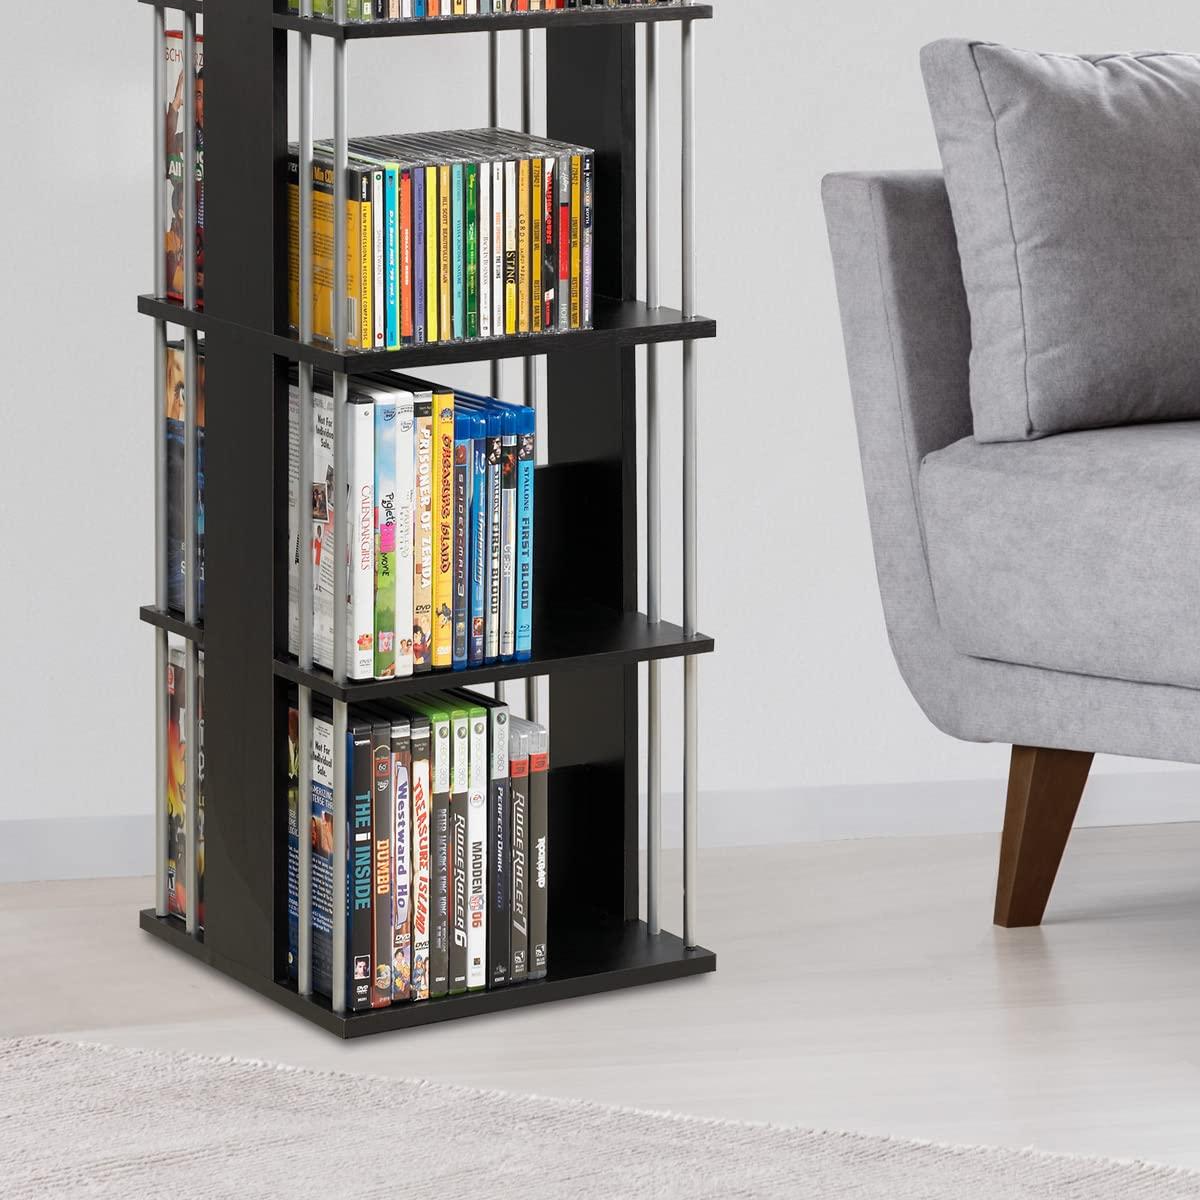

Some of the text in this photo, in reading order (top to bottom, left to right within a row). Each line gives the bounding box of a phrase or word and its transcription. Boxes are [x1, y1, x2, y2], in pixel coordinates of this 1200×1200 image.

[381, 492, 396, 527] Piglet's
[419, 428, 432, 590] PRISONER OF ZENDA
[474, 512, 485, 585] Underdog
[491, 521, 500, 562] FIRST
[521, 517, 530, 557] FIRST
[457, 583, 464, 597] 3
[491, 567, 499, 615] BLOOD
[521, 562, 530, 610] BLOOD
[498, 753, 506, 771] 360
[355, 790, 371, 828] THE
[376, 838, 390, 895] DUMBO
[397, 781, 408, 908] Westward Ho
[413, 777, 428, 935] TREASURE ISLAND
[472, 841, 482, 894] MADDEN
[513, 791, 527, 937] RIDGE RACER 7
[355, 845, 371, 910] INSIDE
[472, 911, 482, 928] 06
